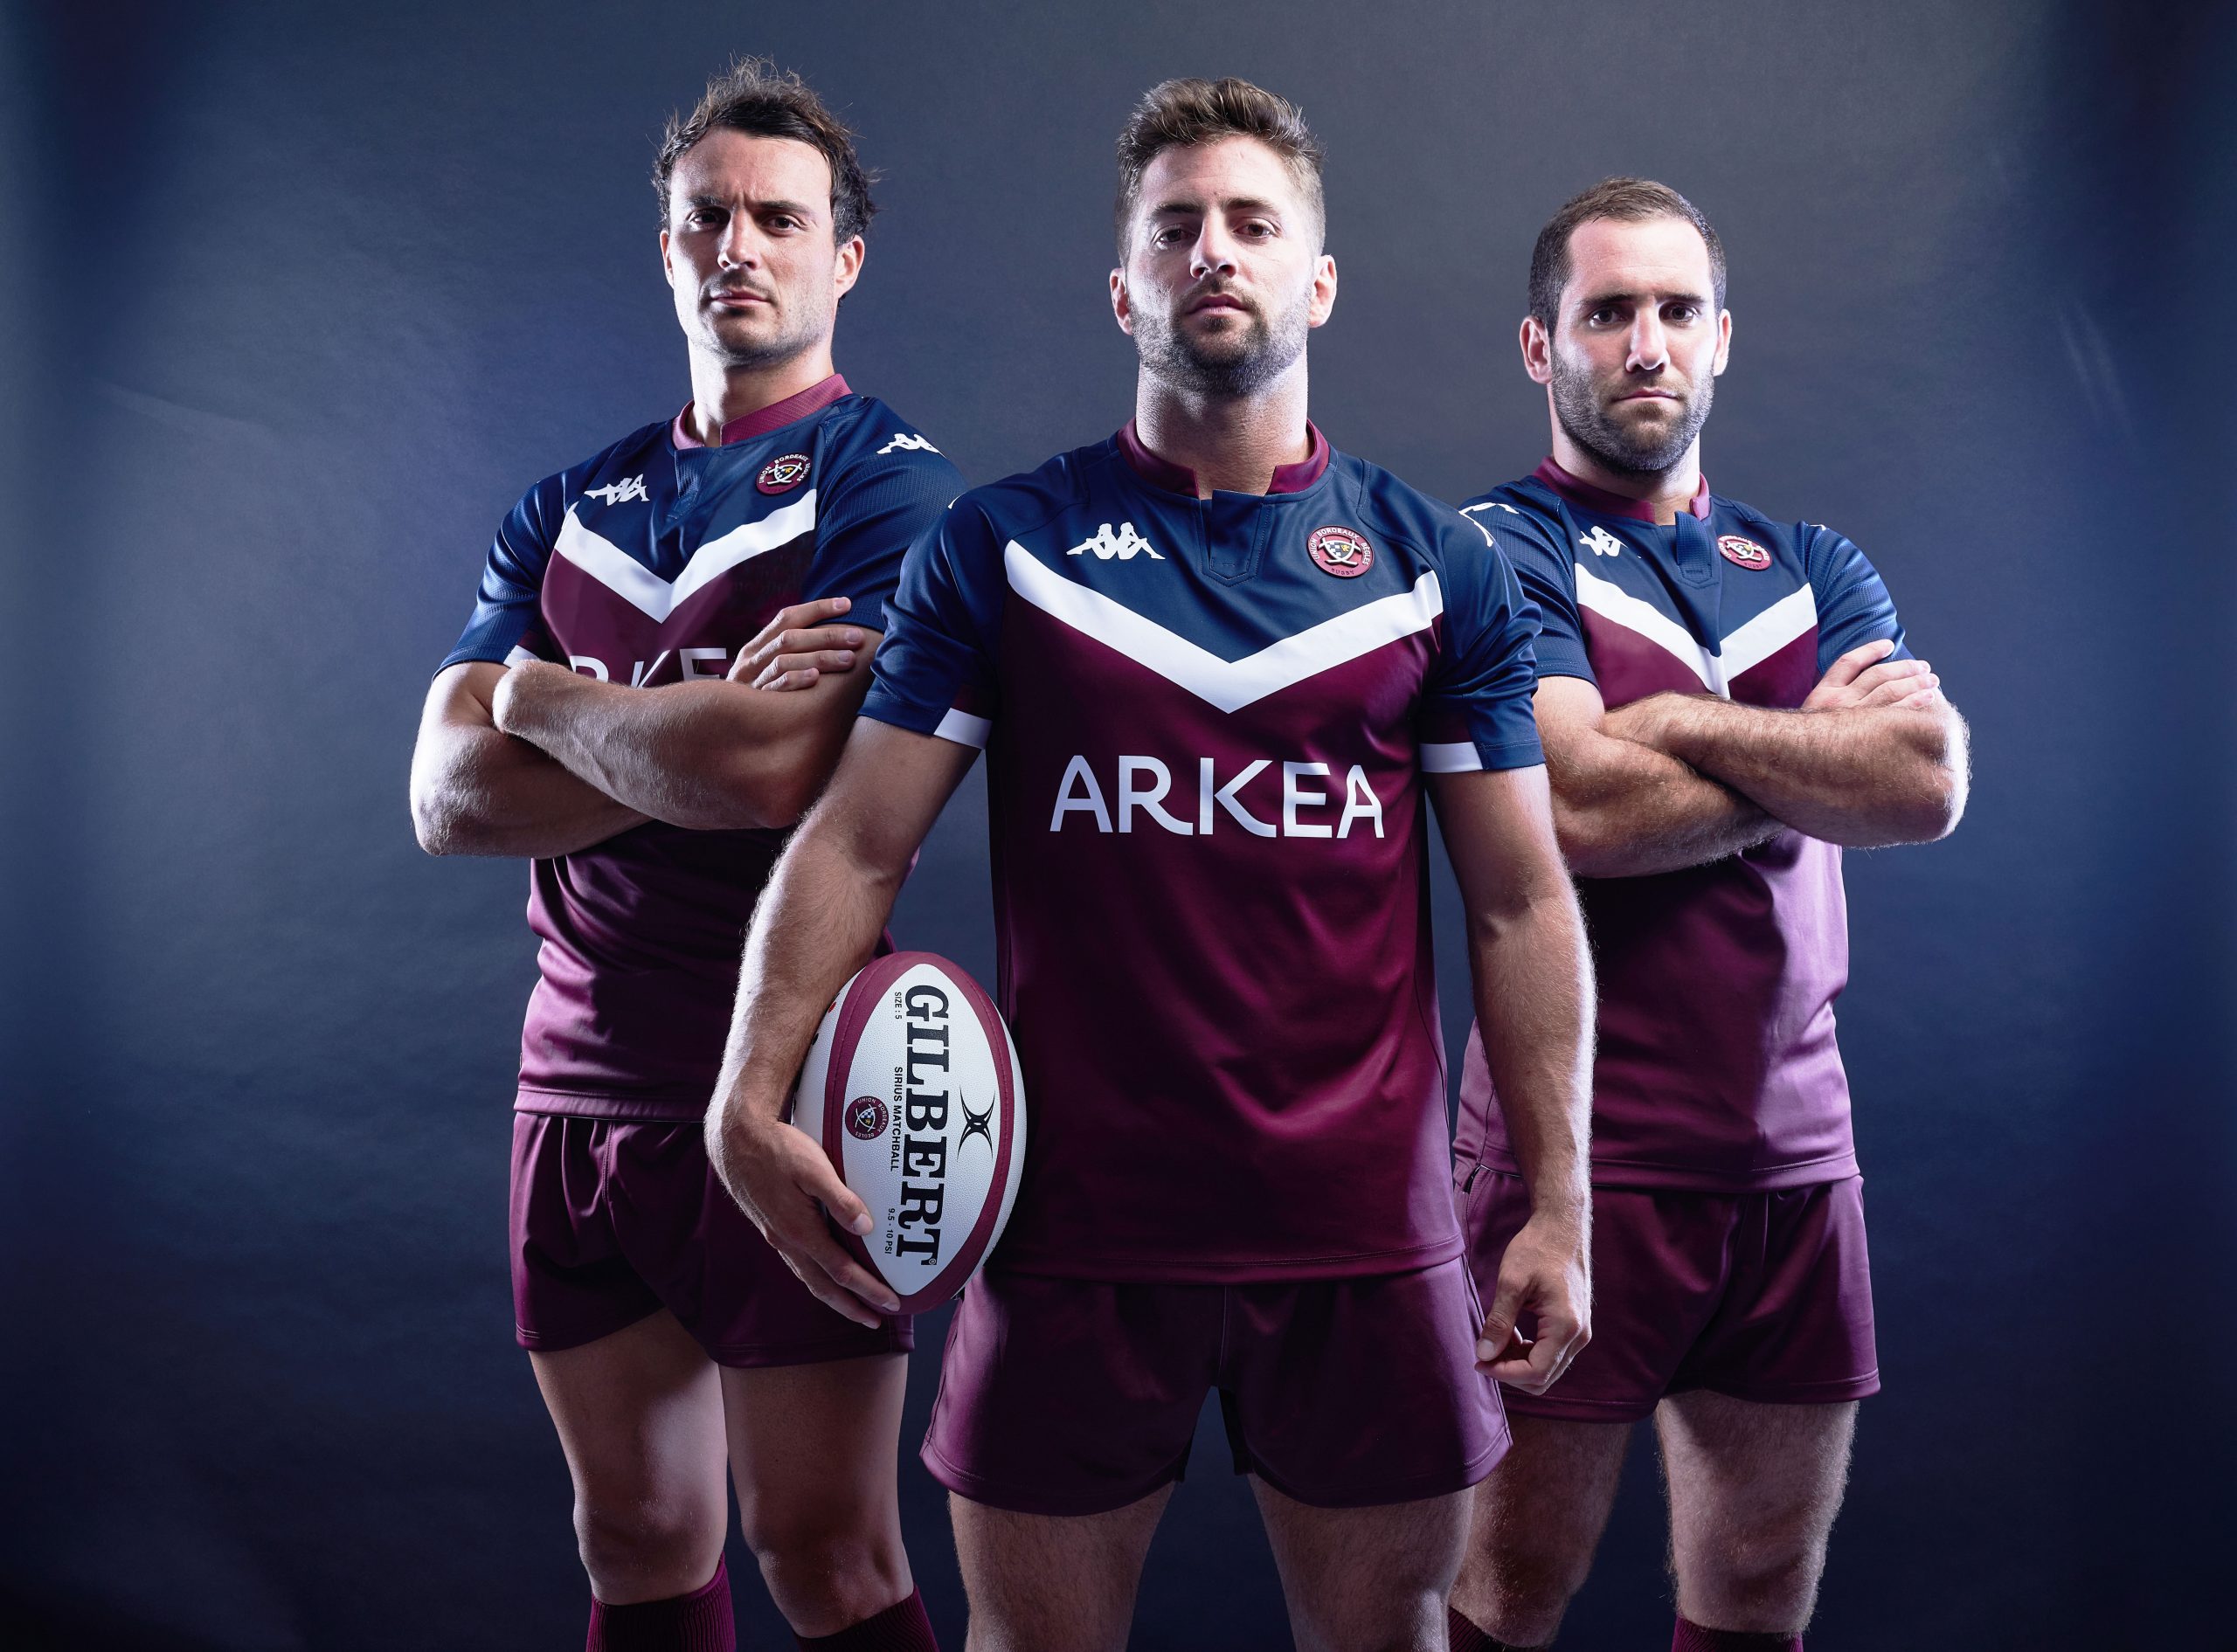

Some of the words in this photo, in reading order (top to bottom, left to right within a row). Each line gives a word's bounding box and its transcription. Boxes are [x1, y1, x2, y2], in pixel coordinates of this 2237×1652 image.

[1310, 537, 1320, 560] UNION
[1316, 527, 1360, 541] BORDEAUX
[1049, 755, 1385, 839] ARKEA
[894, 992, 903, 1009] SIZE
[893, 1067, 904, 1102] SIRIUS
[890, 1104, 903, 1172] MATCHBALL
[896, 985, 950, 1266] GILBERT
[887, 1208, 896, 1221] 9.5
[884, 1241, 893, 1255] PSI
[886, 1228, 894, 1239] 10
